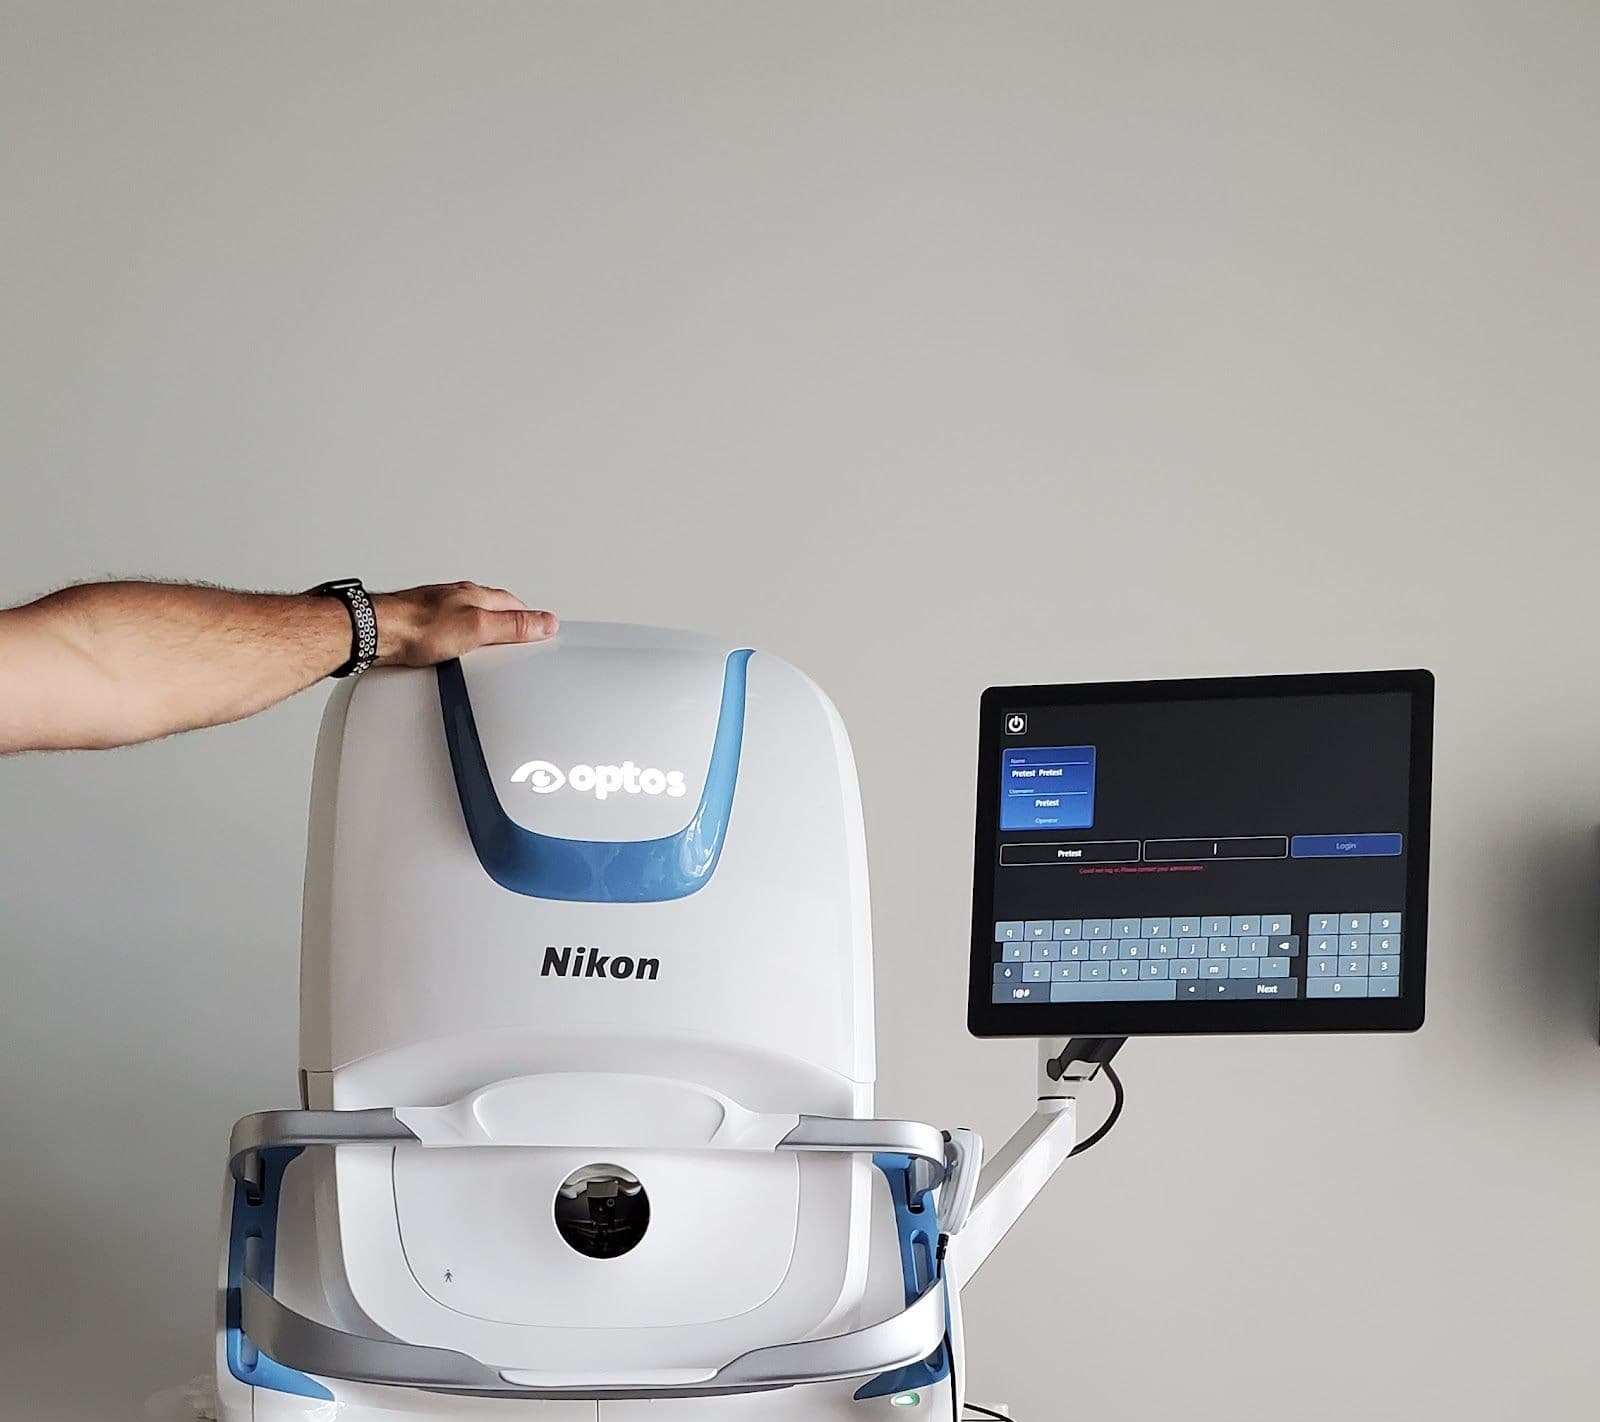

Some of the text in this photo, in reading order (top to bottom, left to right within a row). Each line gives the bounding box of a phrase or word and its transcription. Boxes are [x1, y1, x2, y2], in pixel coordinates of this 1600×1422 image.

[569, 761, 686, 800] optos
[1335, 842, 1357, 851] Login
[1057, 849, 1082, 858] Pretest
[1321, 919, 1389, 929] 7 8 9
[1006, 929, 1013, 938] q
[1123, 926, 1129, 934] t
[1152, 926, 1159, 935] y
[1272, 923, 1280, 932] p
[1071, 946, 1078, 955] d
[1101, 945, 1108, 954] f
[1130, 947, 1137, 956] g
[1160, 944, 1167, 953] h
[1189, 944, 1195, 954] j
[1220, 943, 1227, 952] k
[1319, 940, 1389, 950] 4 5 6
[541, 946, 660, 980] Nikon
[1320, 962, 1388, 971] 1 2 3
[1033, 969, 1040, 977] z
[1062, 969, 1069, 977] x
[1151, 966, 1157, 974] b
[1257, 984, 1278, 994] Next
[1333, 983, 1341, 992] 0
